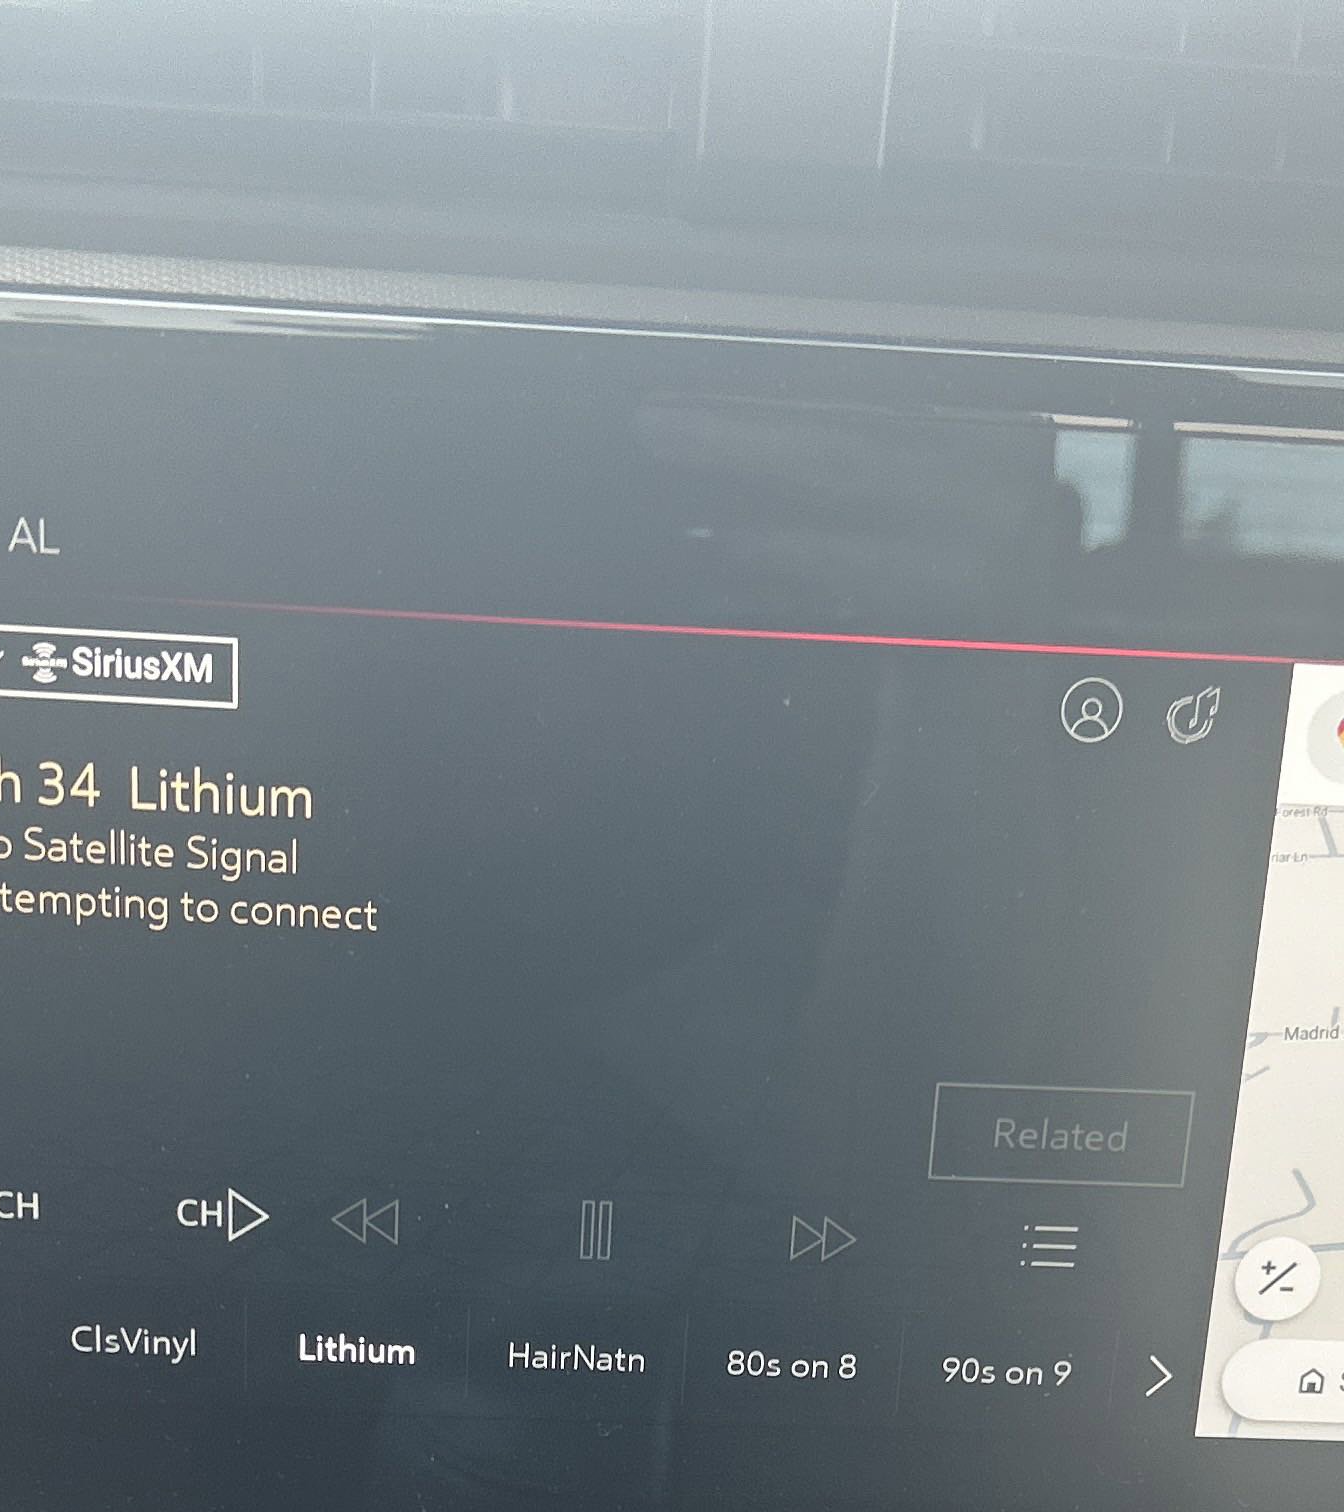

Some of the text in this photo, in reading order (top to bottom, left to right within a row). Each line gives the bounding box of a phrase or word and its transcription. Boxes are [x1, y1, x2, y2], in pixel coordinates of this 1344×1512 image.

[7, 516, 61, 555] AL
[71, 645, 214, 684] SiriusXM
[37, 761, 101, 808] 34
[130, 765, 314, 820] Lithium
[23, 826, 175, 868] Satellite
[186, 834, 298, 882] Signal
[179, 891, 219, 923] to
[230, 900, 378, 932] connect
[1284, 1024, 1338, 1042] Madrid
[993, 1117, 1129, 1153] Related
[176, 1198, 224, 1228] CH
[71, 1324, 196, 1365] ClsVinyl
[299, 1332, 416, 1365] Lithium
[508, 1341, 646, 1373] HairNatn
[726, 1349, 857, 1380] 80s on 8
[941, 1356, 1073, 1386] 90s on 9
